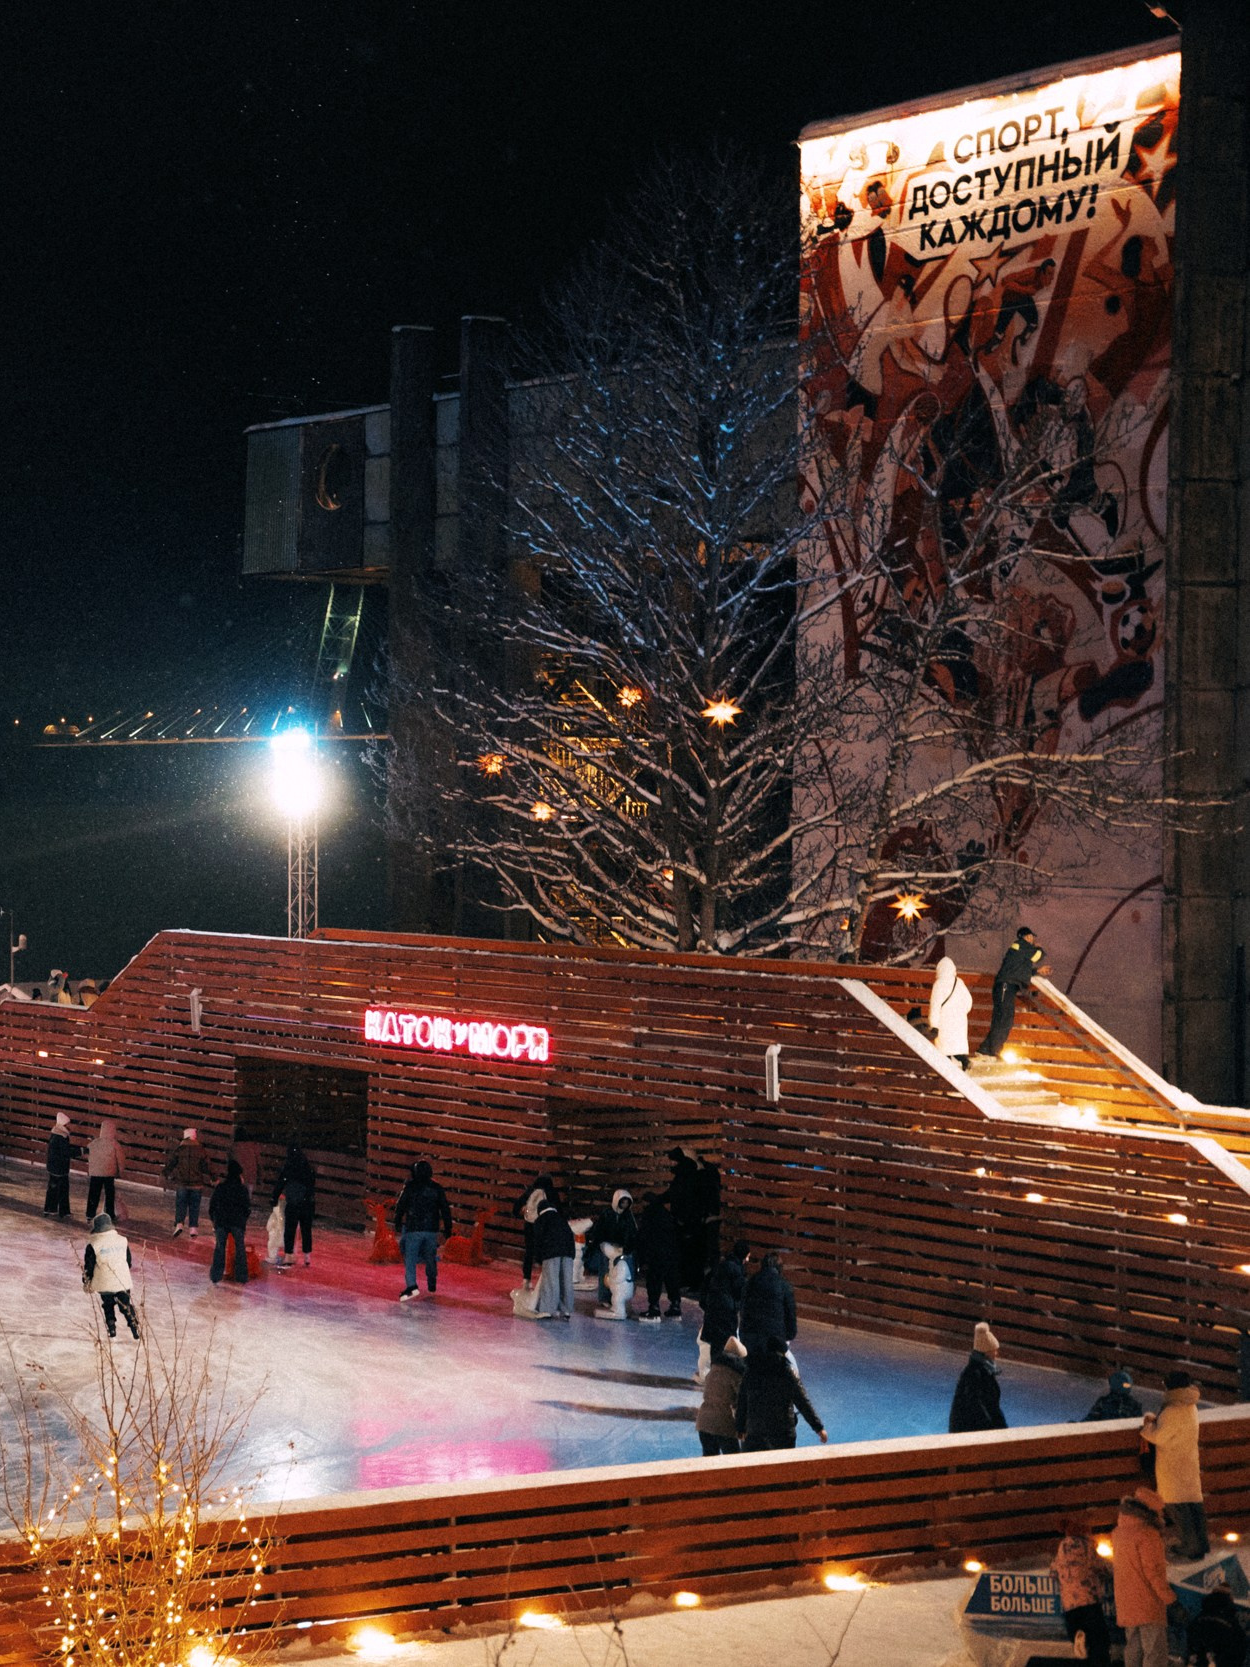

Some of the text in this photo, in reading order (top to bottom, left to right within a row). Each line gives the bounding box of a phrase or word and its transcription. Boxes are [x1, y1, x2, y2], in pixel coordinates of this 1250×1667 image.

[953, 106, 1069, 164] СПОРТ,
[909, 121, 1121, 220] ДОСТУПНЫЙ
[920, 184, 1099, 250] КАЖДОМУ!
[365, 1010, 452, 1049] КАТОК
[469, 1022, 549, 1062] МОРЯ
[991, 1595, 1055, 1614] БОЛЬШЕ
